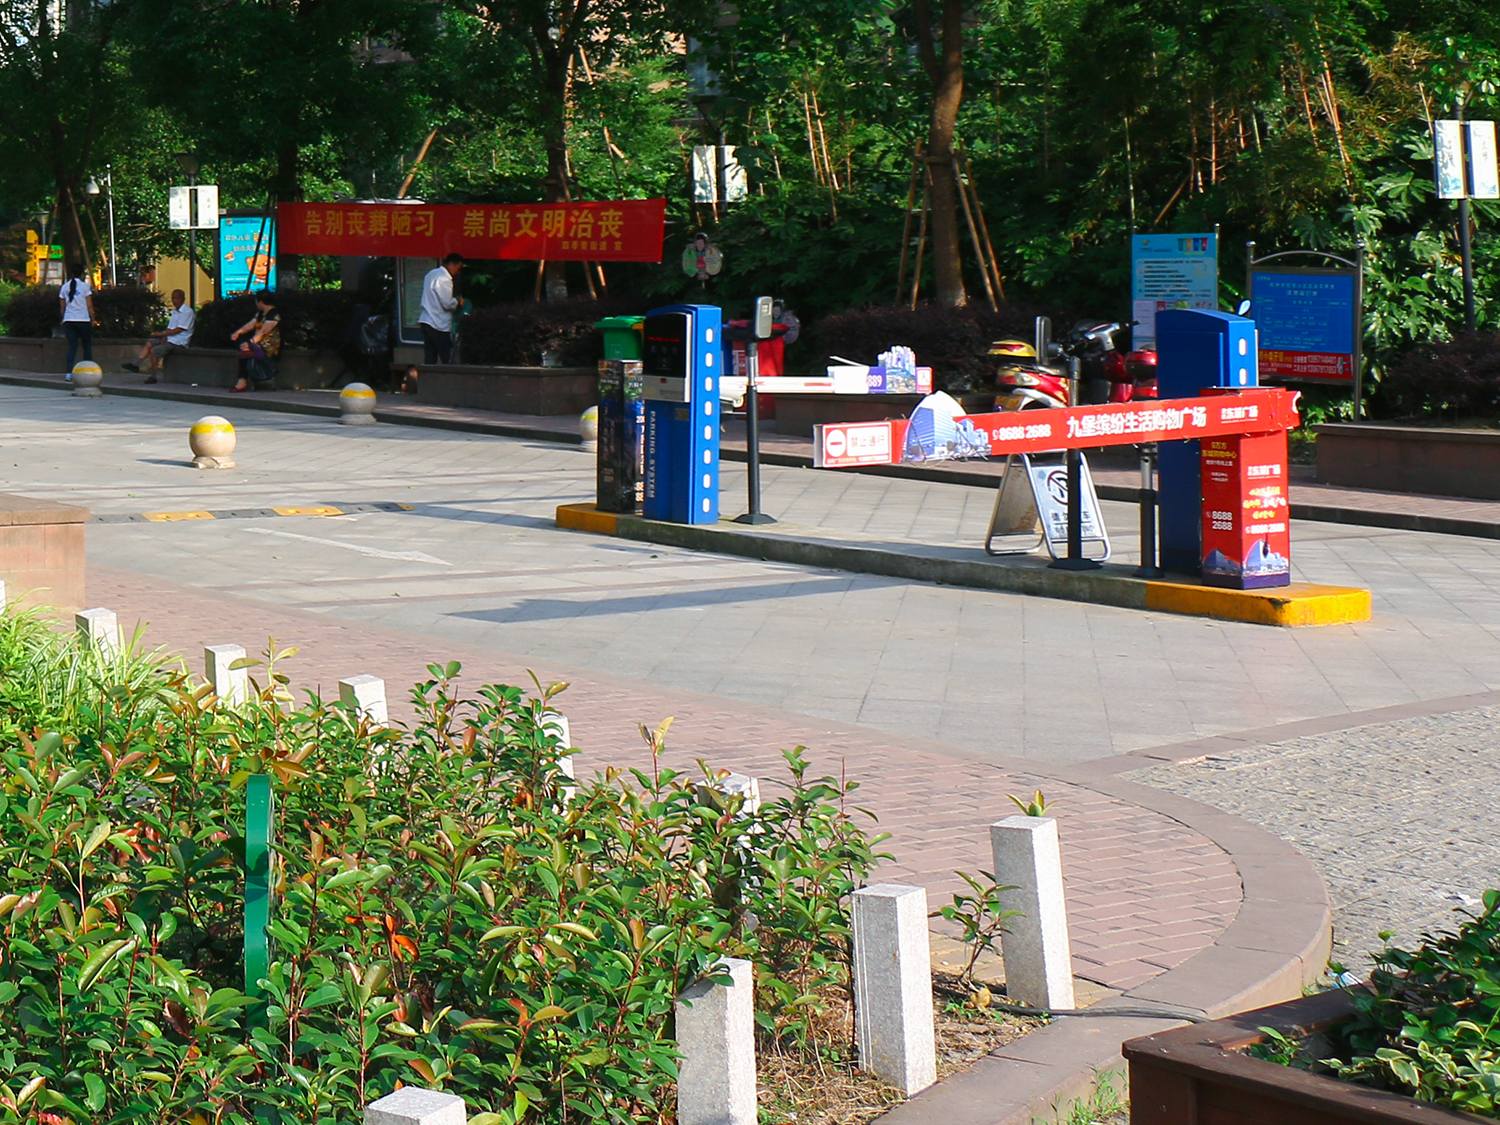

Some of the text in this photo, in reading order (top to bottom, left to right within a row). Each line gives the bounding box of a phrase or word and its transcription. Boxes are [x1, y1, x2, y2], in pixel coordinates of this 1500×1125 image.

[304, 208, 624, 239] 告别丧葬陋习 崇尚文明治丧
[1067, 406, 1207, 439] 九堡缤纷生活购物广场
[999, 423, 1051, 441] 8688 2688
[850, 435, 885, 448] 禁止通行
[1211, 510, 1233, 521] 8688
[1211, 520, 1233, 531] 2688
